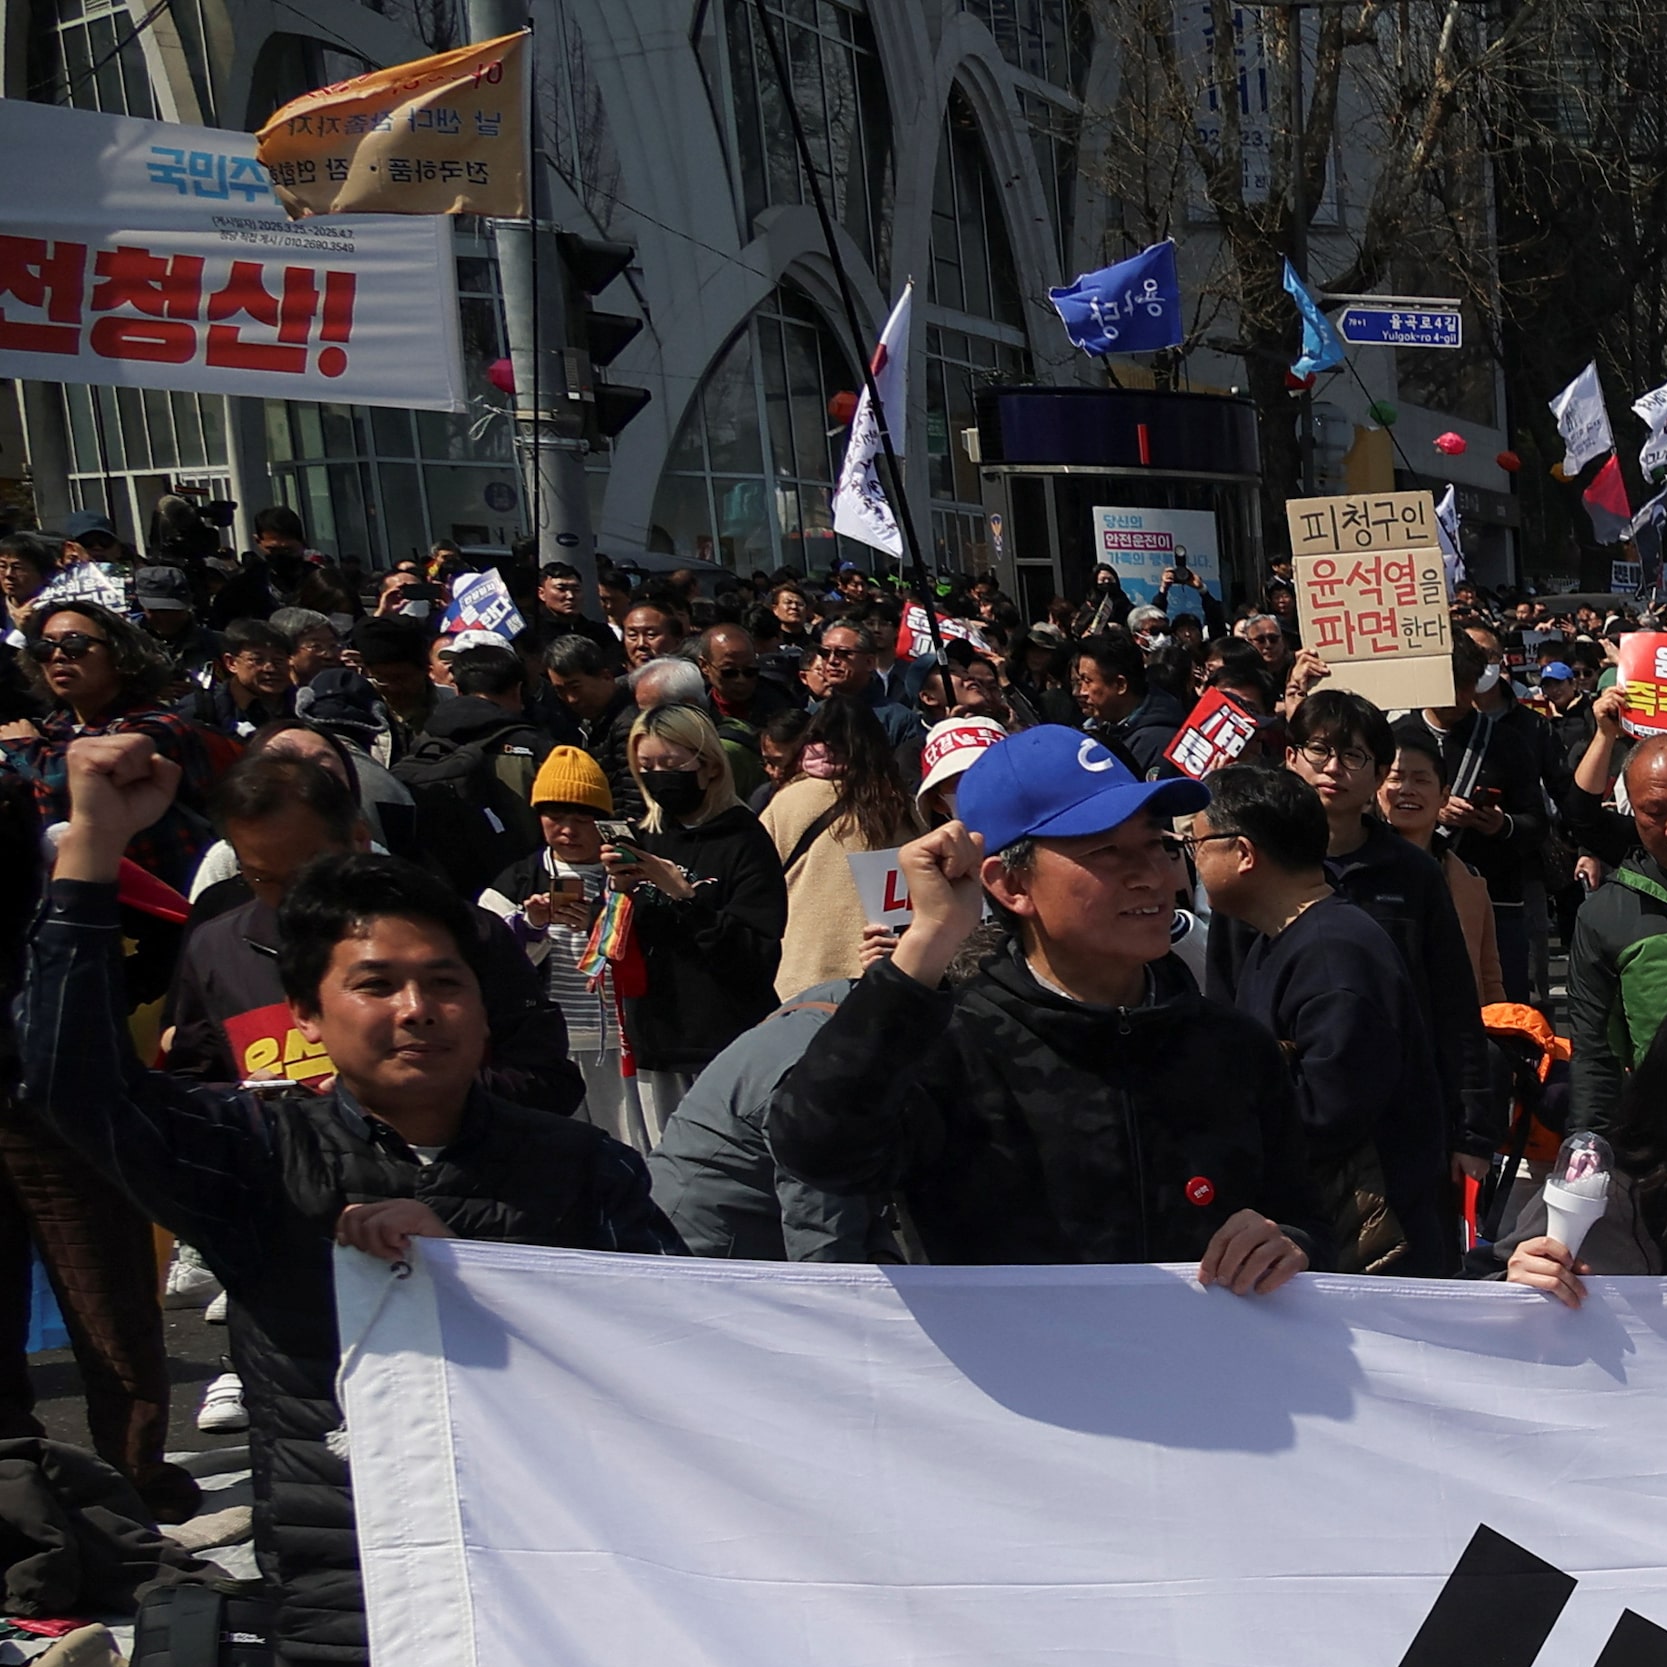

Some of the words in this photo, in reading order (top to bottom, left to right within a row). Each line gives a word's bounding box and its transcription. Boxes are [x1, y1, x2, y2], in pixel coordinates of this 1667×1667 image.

[1105, 532, 1171, 550] 안전운전이
[1300, 500, 1429, 551] 피청구인
[1306, 553, 1442, 610] 윤석열을
[1311, 606, 1447, 655] 파면한다
